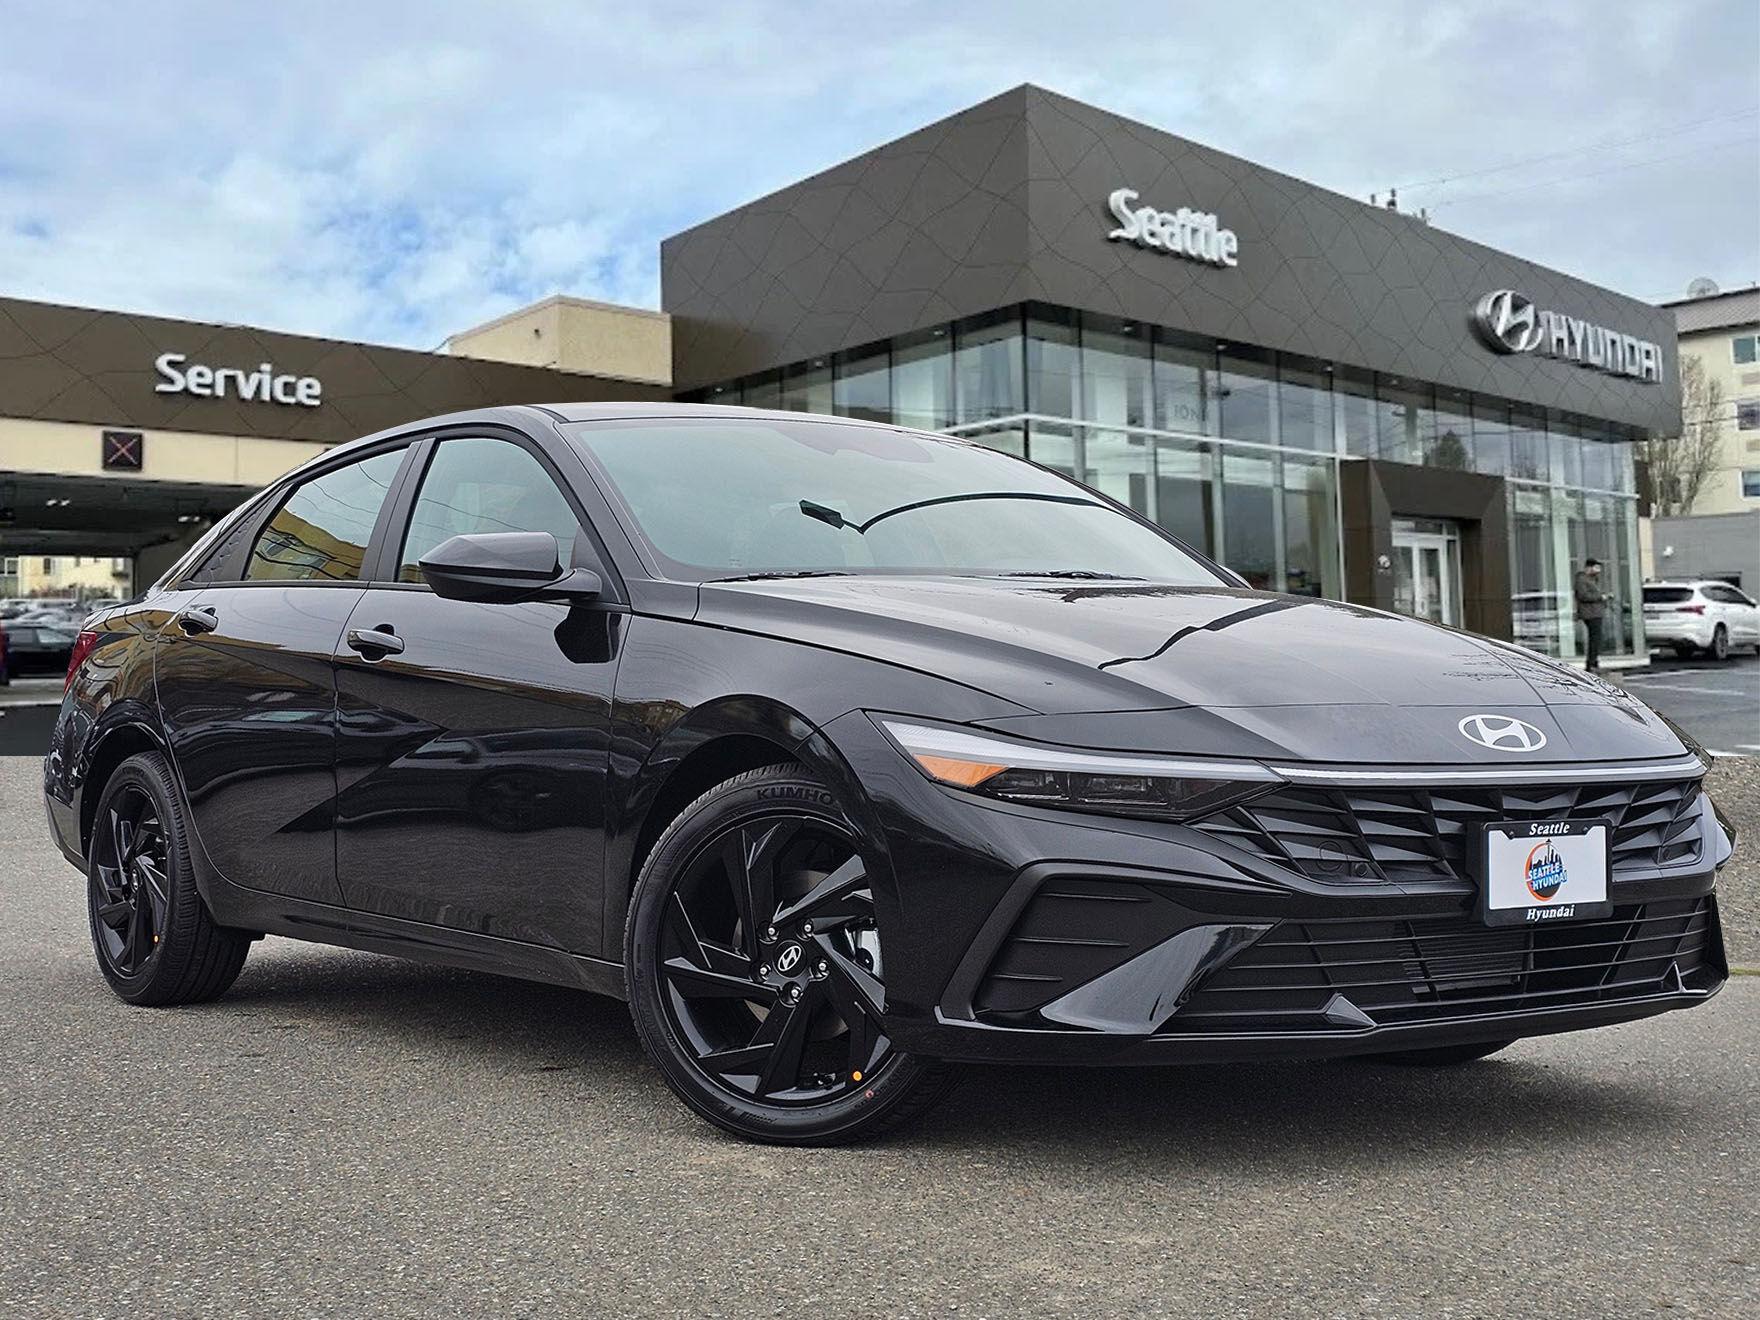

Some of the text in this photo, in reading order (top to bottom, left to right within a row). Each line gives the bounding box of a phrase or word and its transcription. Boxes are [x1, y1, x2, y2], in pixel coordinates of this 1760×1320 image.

[1108, 188, 1238, 267] Seattle
[1540, 310, 1663, 384] HYUNDAI
[154, 352, 322, 407] Service
[756, 786, 834, 805] KUMHO
[1529, 822, 1570, 836] Seattle
[1527, 864, 1561, 881] SEATTLE
[1532, 869, 1568, 891] HYUNDAI
[1526, 905, 1574, 922] Hyundai
